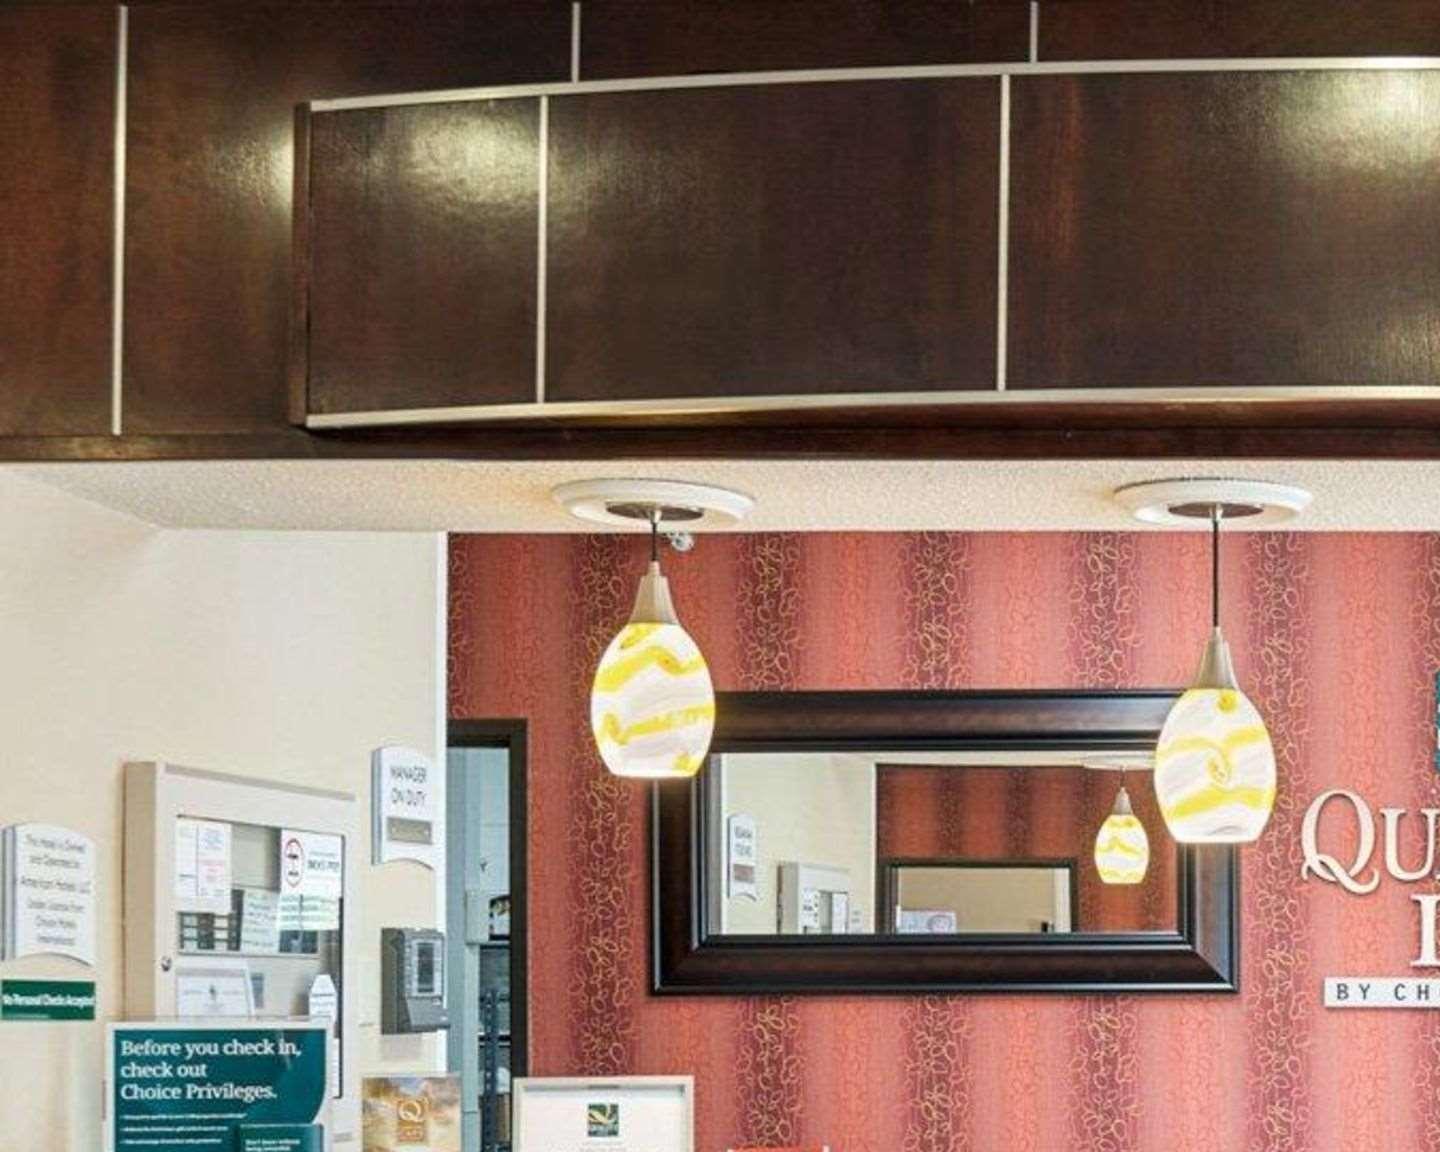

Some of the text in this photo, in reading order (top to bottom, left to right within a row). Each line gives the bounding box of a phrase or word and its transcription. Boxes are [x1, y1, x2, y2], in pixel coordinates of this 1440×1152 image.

[390, 765, 427, 783] MANAGER
[1337, 984, 1371, 1001] BY
[121, 1039, 302, 1061] Before you check in,
[121, 1062, 208, 1078] check out
[121, 1083, 277, 1102] Choice Privileges.
